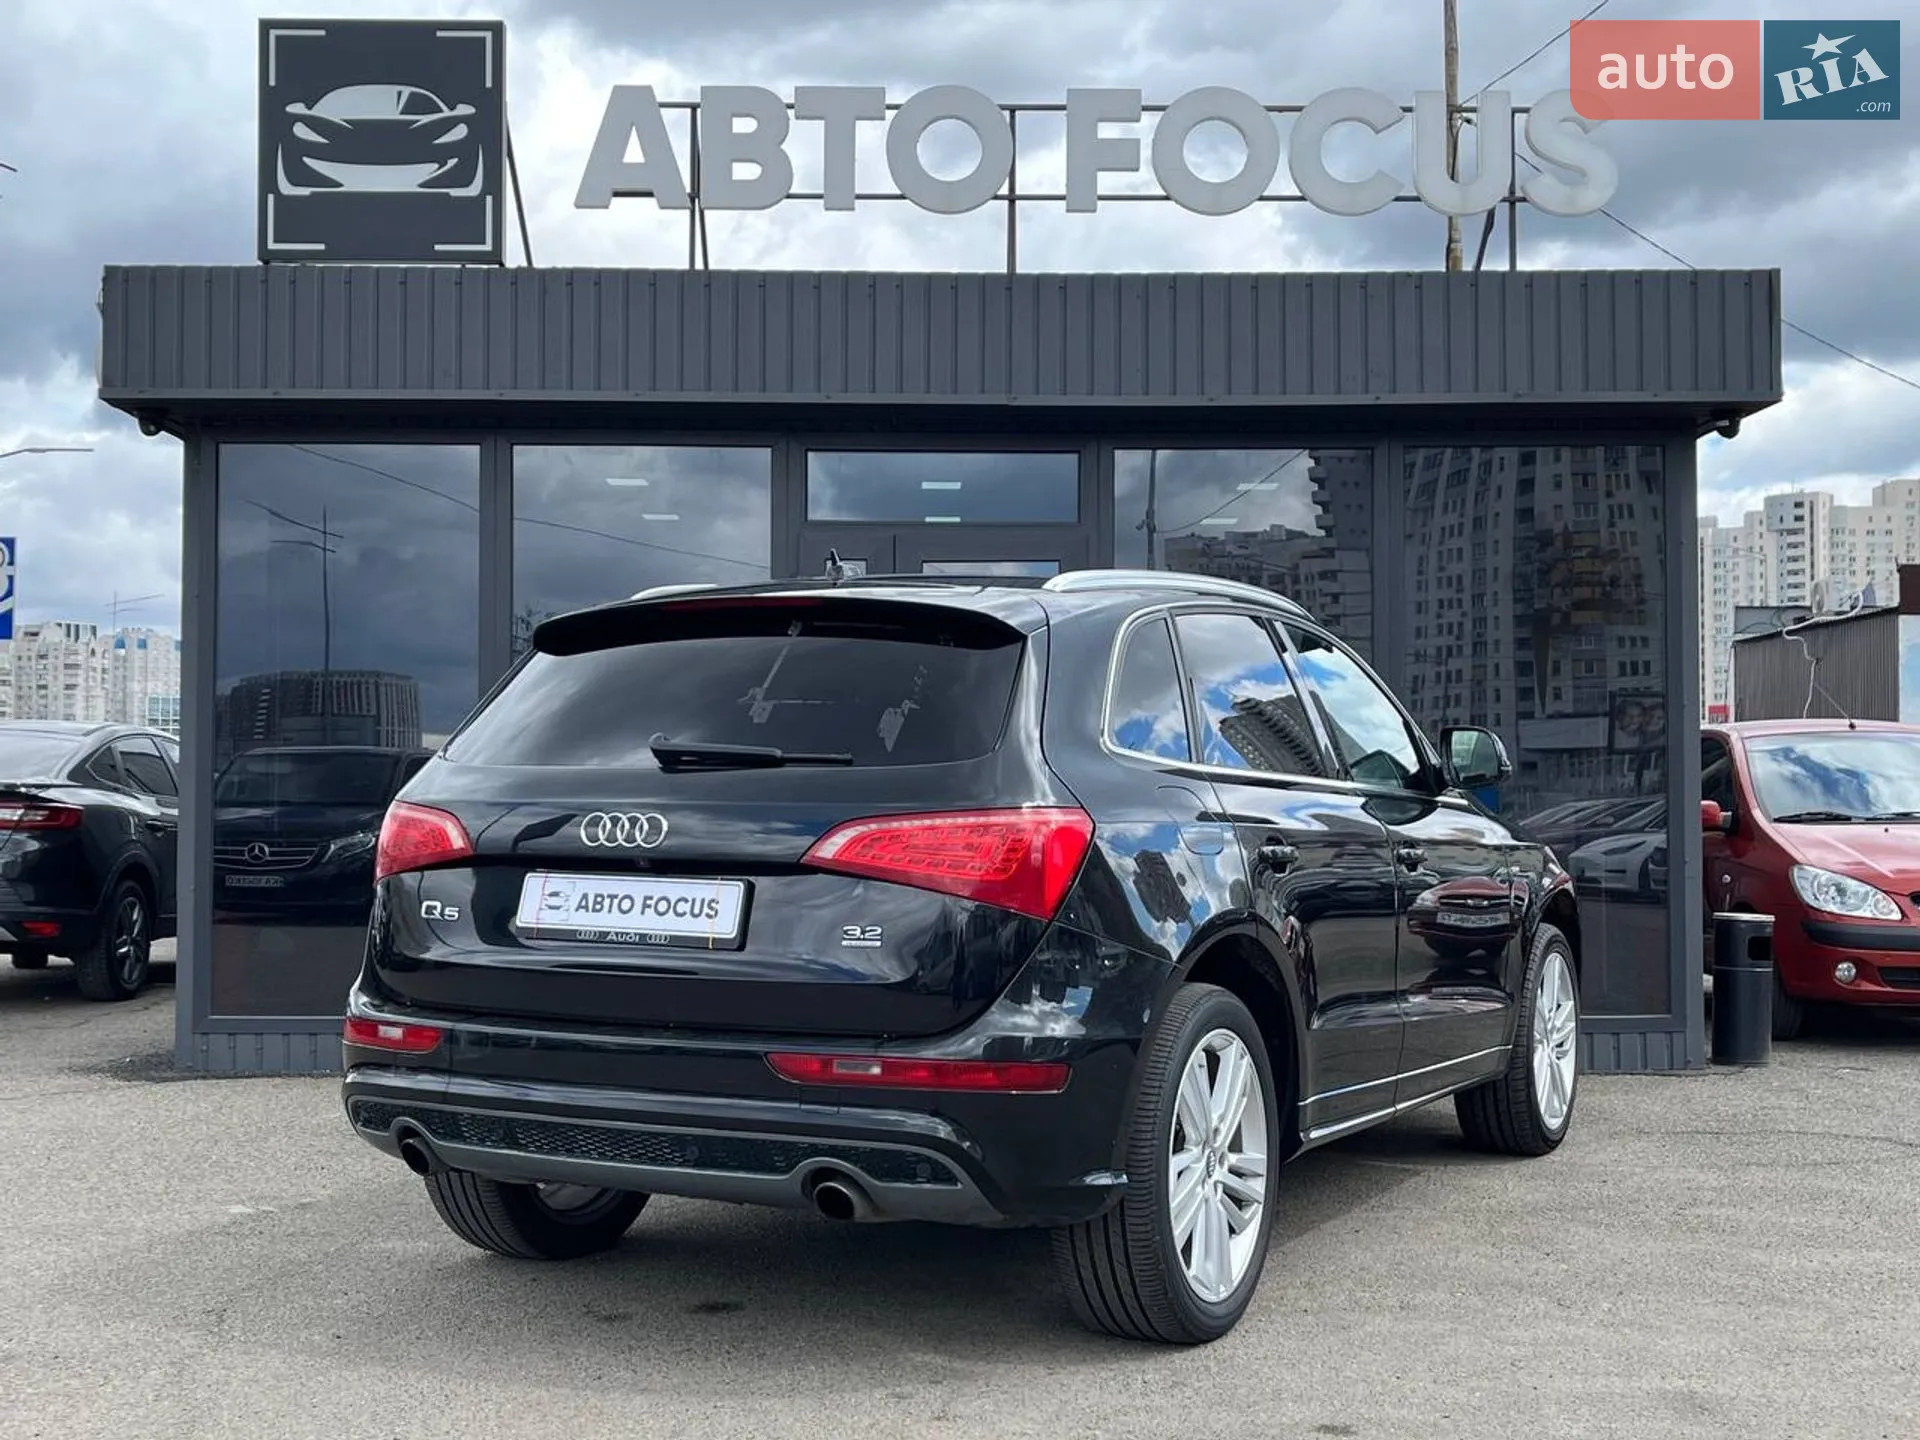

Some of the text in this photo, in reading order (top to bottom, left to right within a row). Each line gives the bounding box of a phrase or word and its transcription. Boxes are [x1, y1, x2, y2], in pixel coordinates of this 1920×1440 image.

[1065, 86, 1618, 216] FOCUS
[421, 900, 459, 920] Q5
[640, 895, 720, 919] FOCUS
[605, 931, 640, 943] Audi
[842, 925, 882, 939] 3.2
